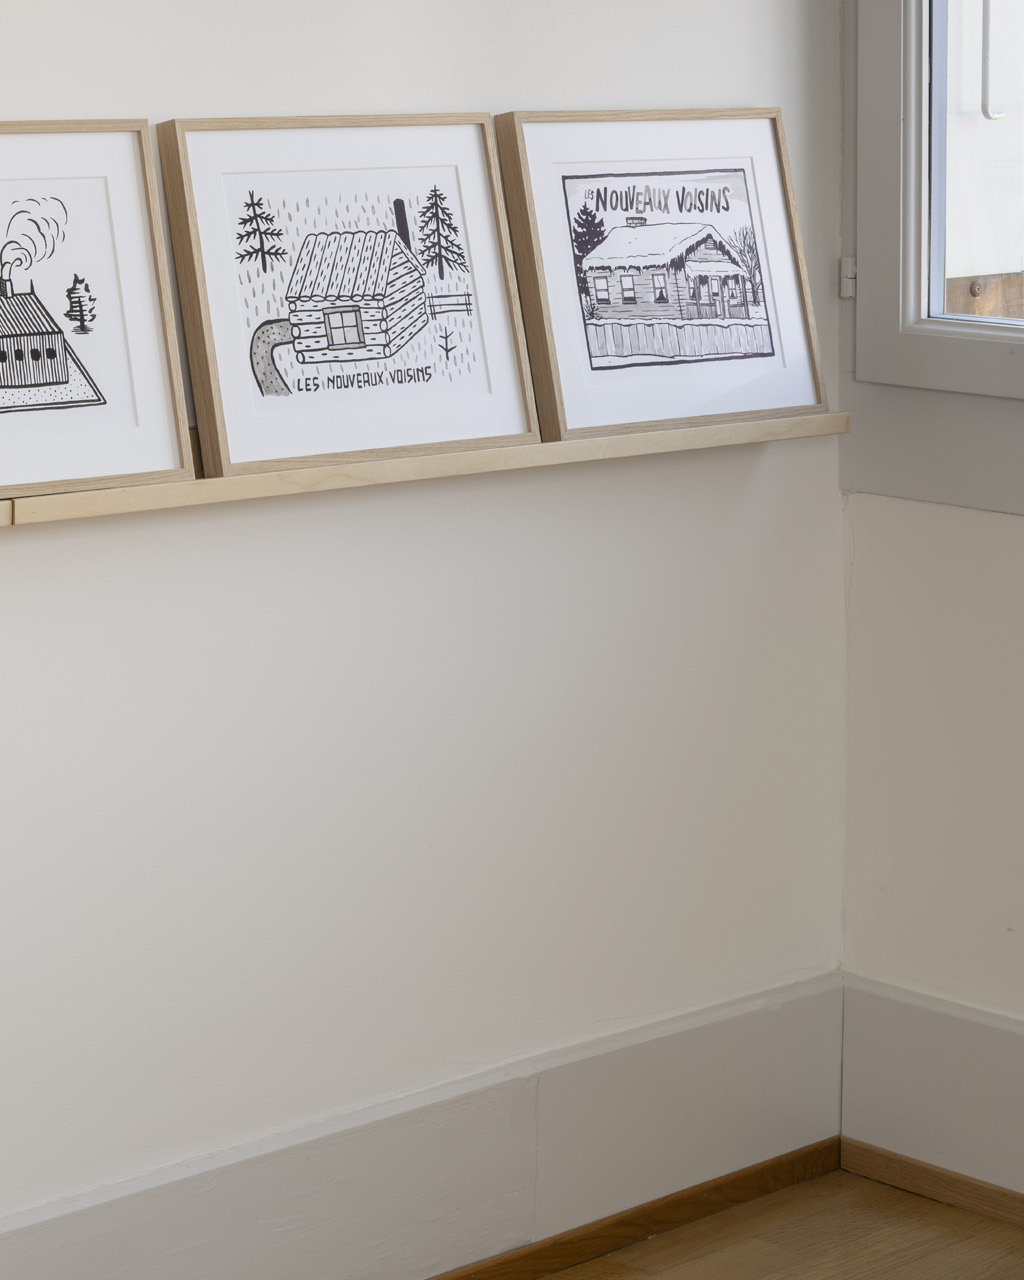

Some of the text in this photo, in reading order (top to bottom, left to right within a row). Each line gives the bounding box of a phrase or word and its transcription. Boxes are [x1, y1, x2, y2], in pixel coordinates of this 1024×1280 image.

[584, 184, 731, 215] LES NOUVEAUX VOISINS
[297, 365, 432, 392] LES NOUVEAUX VOISINS
